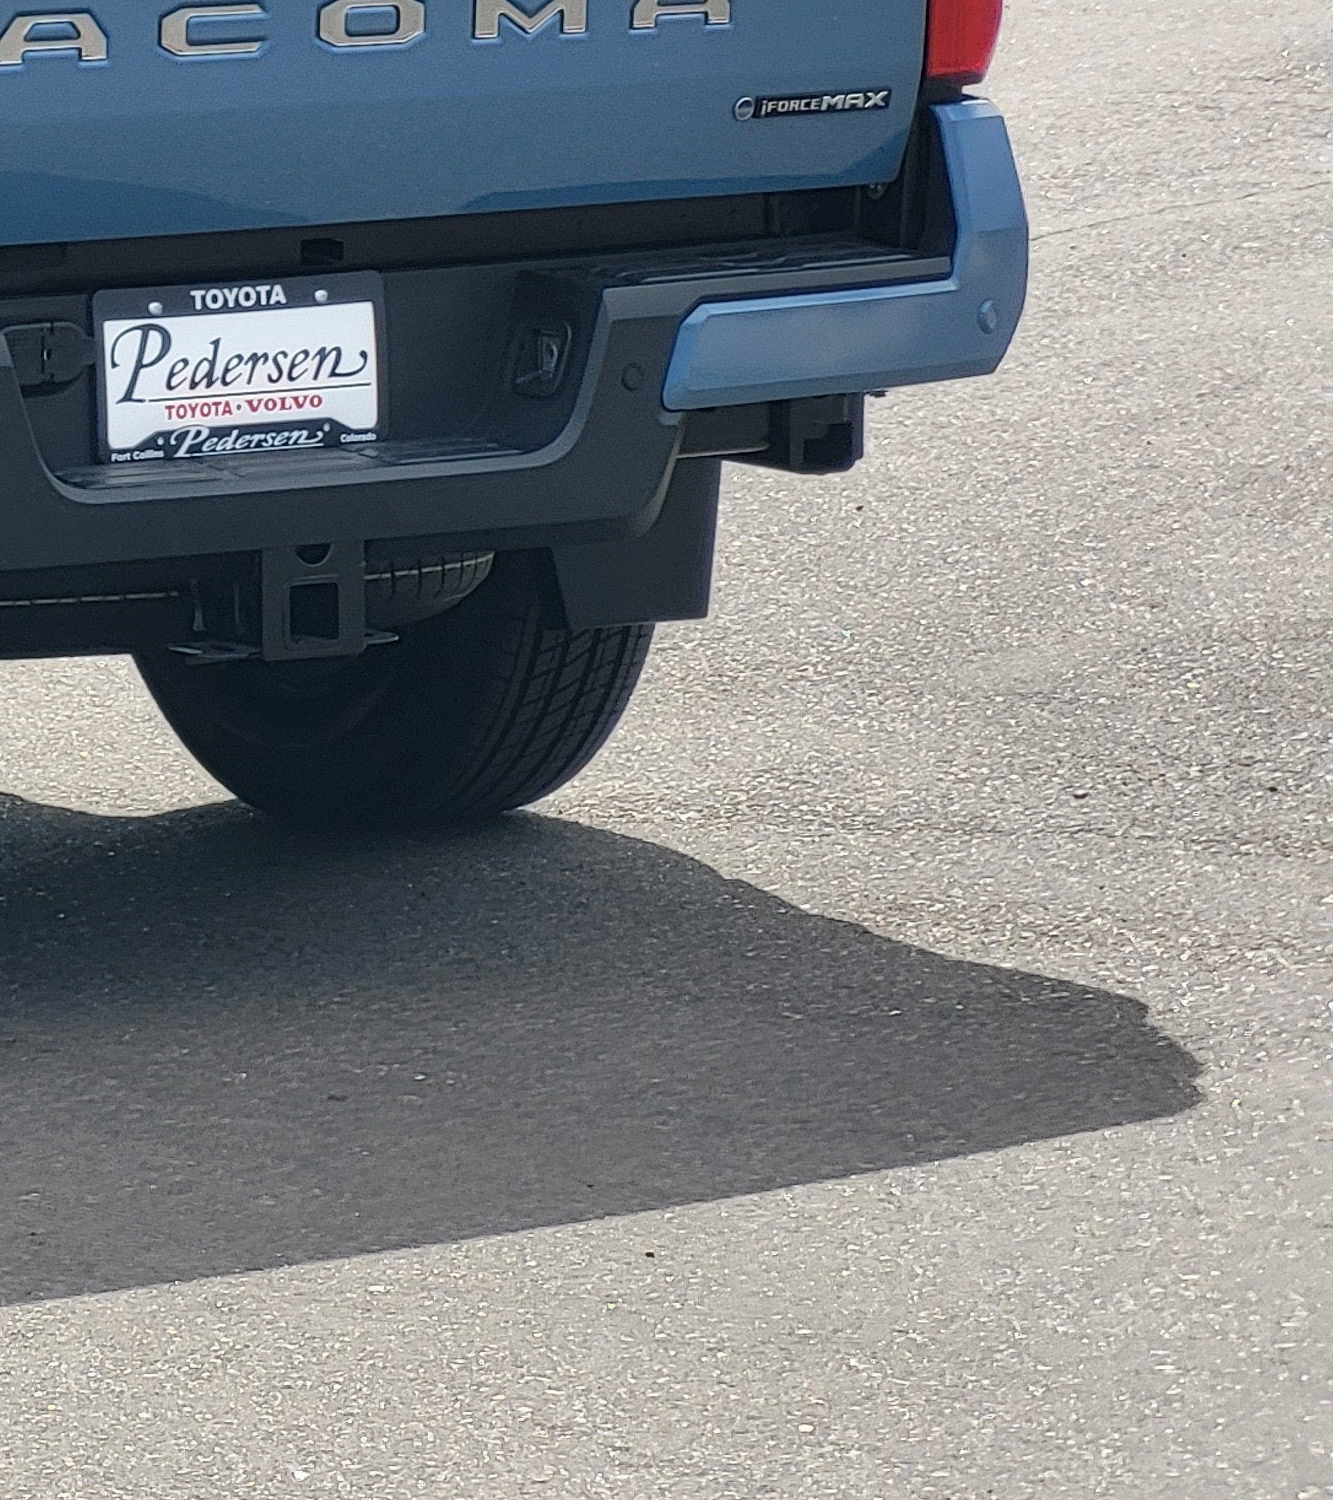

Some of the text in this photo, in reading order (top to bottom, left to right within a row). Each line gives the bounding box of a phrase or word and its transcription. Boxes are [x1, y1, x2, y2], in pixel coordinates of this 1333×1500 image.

[189, 284, 288, 311] TOYOTA
[110, 323, 368, 404] Pedersen
[165, 394, 323, 420] TOYOTA VOLVO
[169, 424, 324, 458] Pedersen
